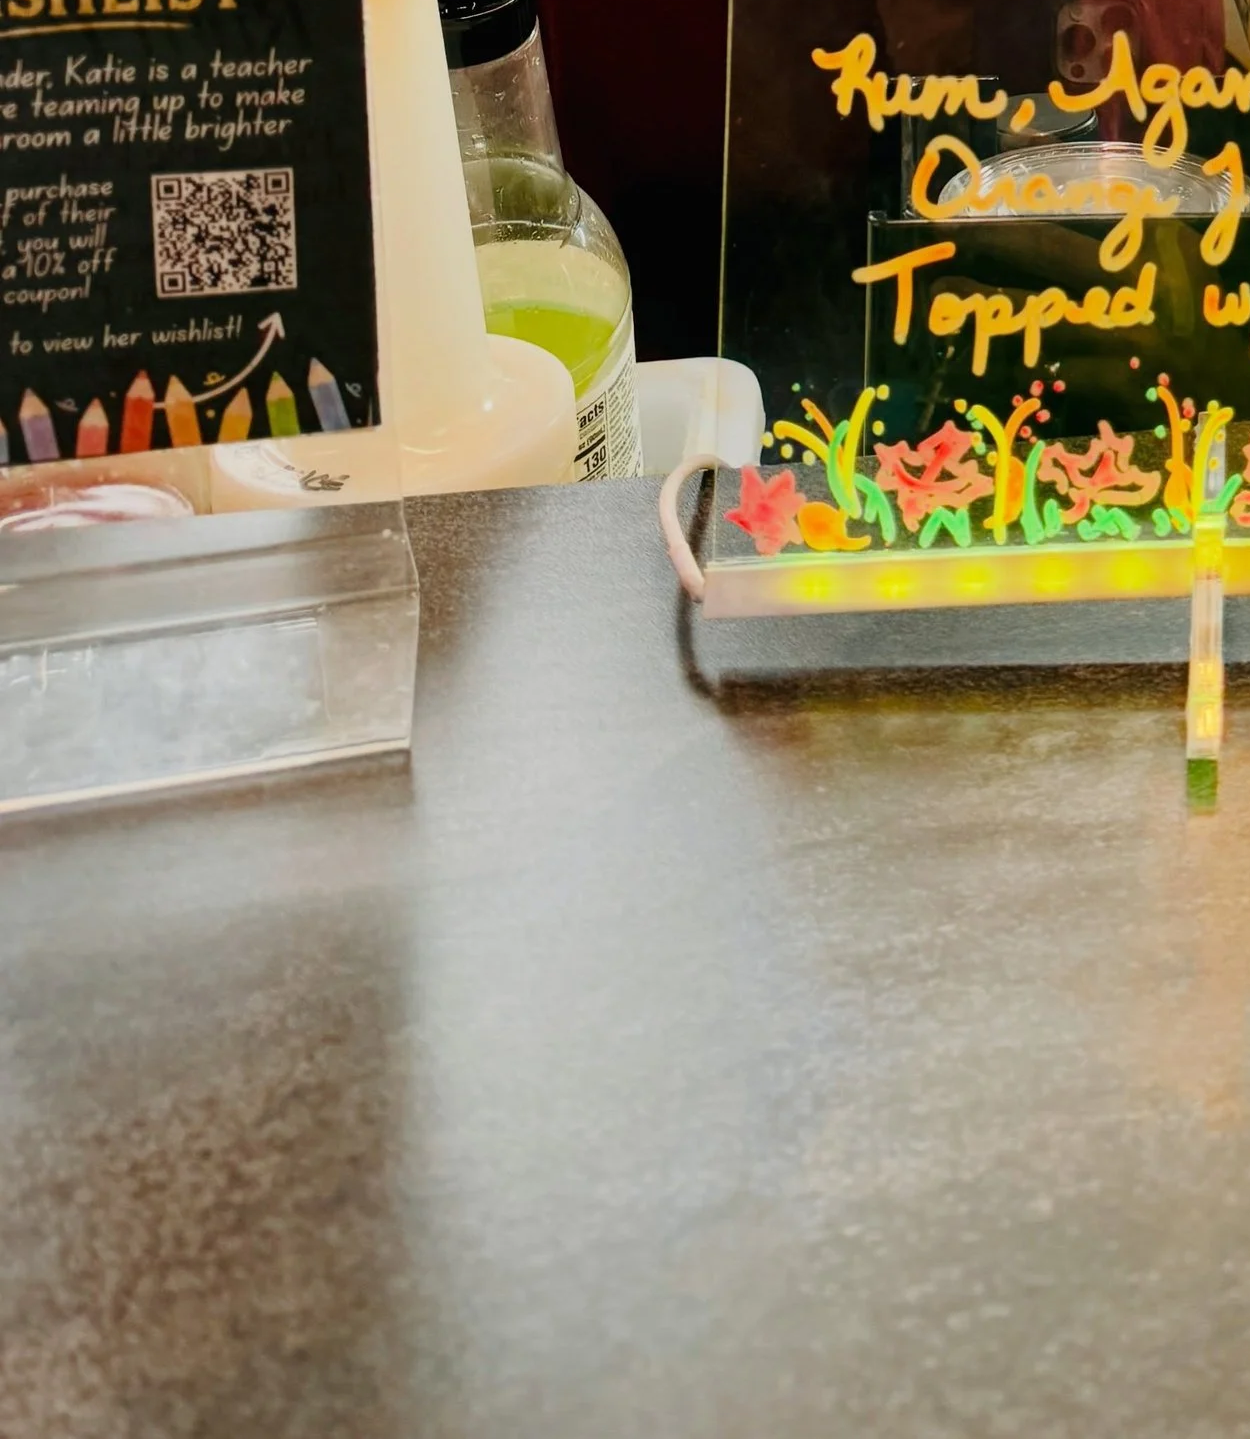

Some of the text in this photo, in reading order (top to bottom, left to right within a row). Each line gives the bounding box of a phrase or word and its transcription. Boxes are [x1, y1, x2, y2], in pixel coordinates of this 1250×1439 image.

[65, 54, 136, 86] Katie
[149, 57, 168, 83] is
[181, 65, 197, 80] a
[210, 47, 312, 78] teacher
[812, 33, 1035, 133] Rum,
[33, 89, 140, 121] teaming
[153, 97, 185, 123] up
[198, 82, 223, 108] to
[236, 80, 305, 107] make
[0, 112, 292, 151] room a little brighter
[5, 173, 113, 206] purchase
[912, 135, 1180, 271] Orange
[23, 201, 50, 226] of
[60, 200, 116, 224] their
[17, 234, 59, 263] you
[69, 223, 107, 249] will
[1, 247, 117, 280] a 10% off
[851, 241, 1160, 377] Topped
[10, 315, 243, 355] to view her wishlist!
[578, 400, 605, 429] acts
[583, 445, 607, 474] 130
